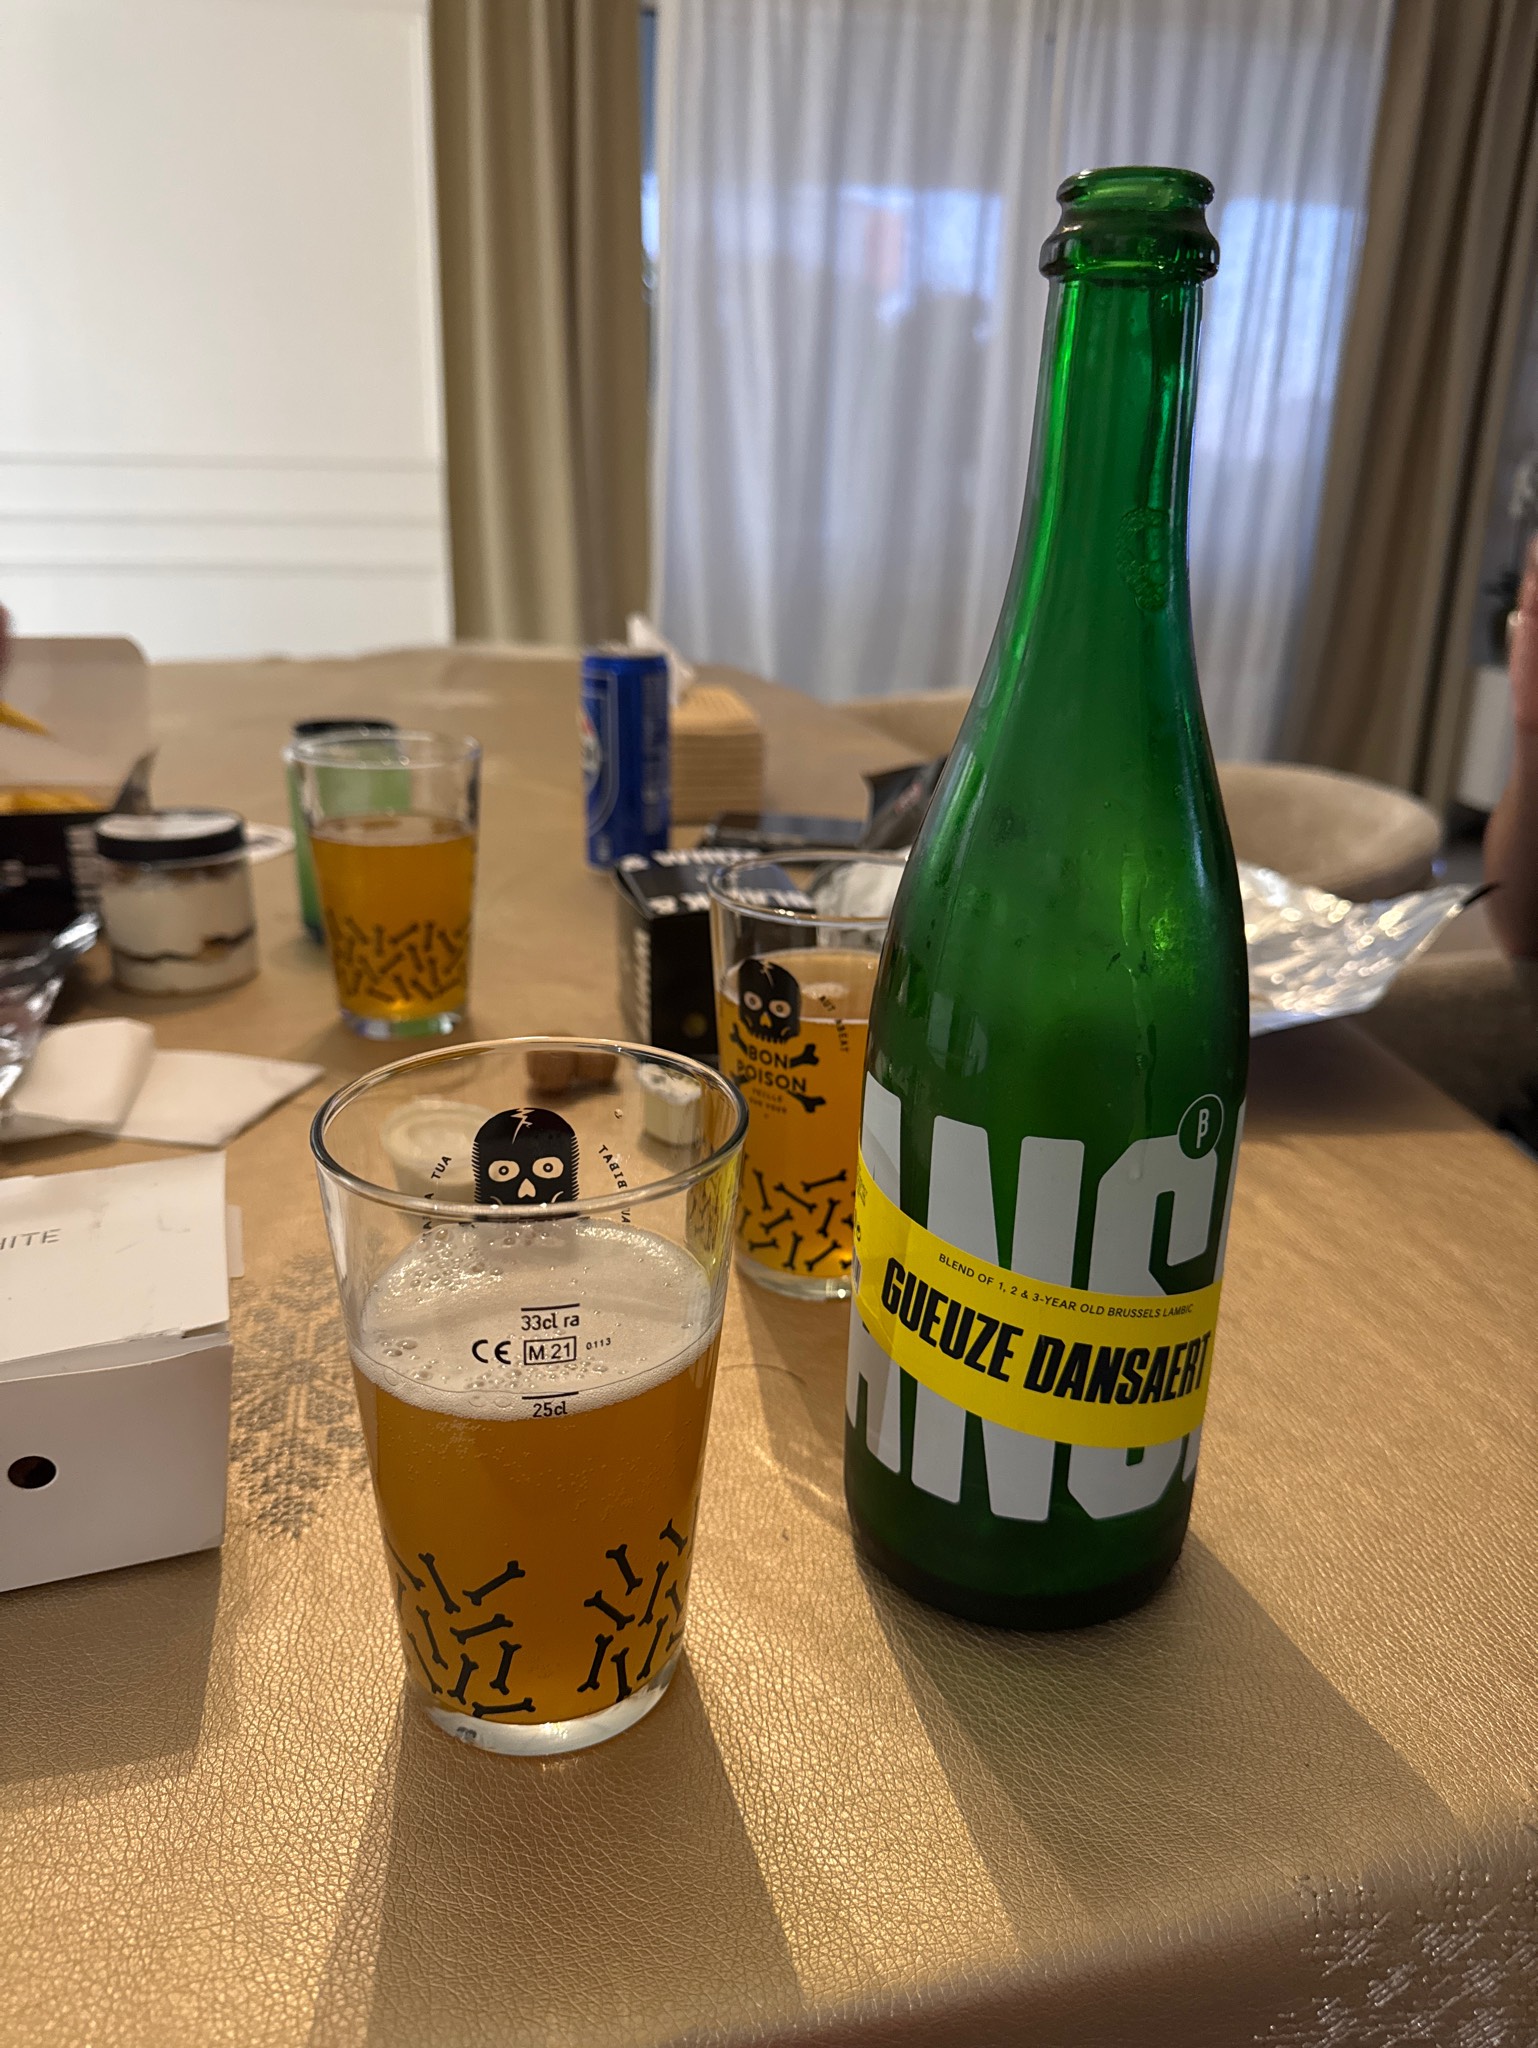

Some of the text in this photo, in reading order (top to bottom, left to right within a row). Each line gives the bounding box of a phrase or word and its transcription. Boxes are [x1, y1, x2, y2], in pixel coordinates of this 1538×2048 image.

[748, 1045, 788, 1069] BON
[737, 1059, 806, 1092] POISON
[939, 1253, 1194, 1318] BLEND OF 1, 2 & 3-YEAR OLD BRUSSELS LAMBIC
[521, 1313, 580, 1331] 33cl ra
[881, 1257, 1212, 1405] GUEUZE DANSAERT
[471, 1337, 612, 1365] CE M 21 0113
[533, 1401, 568, 1418] 25cl
